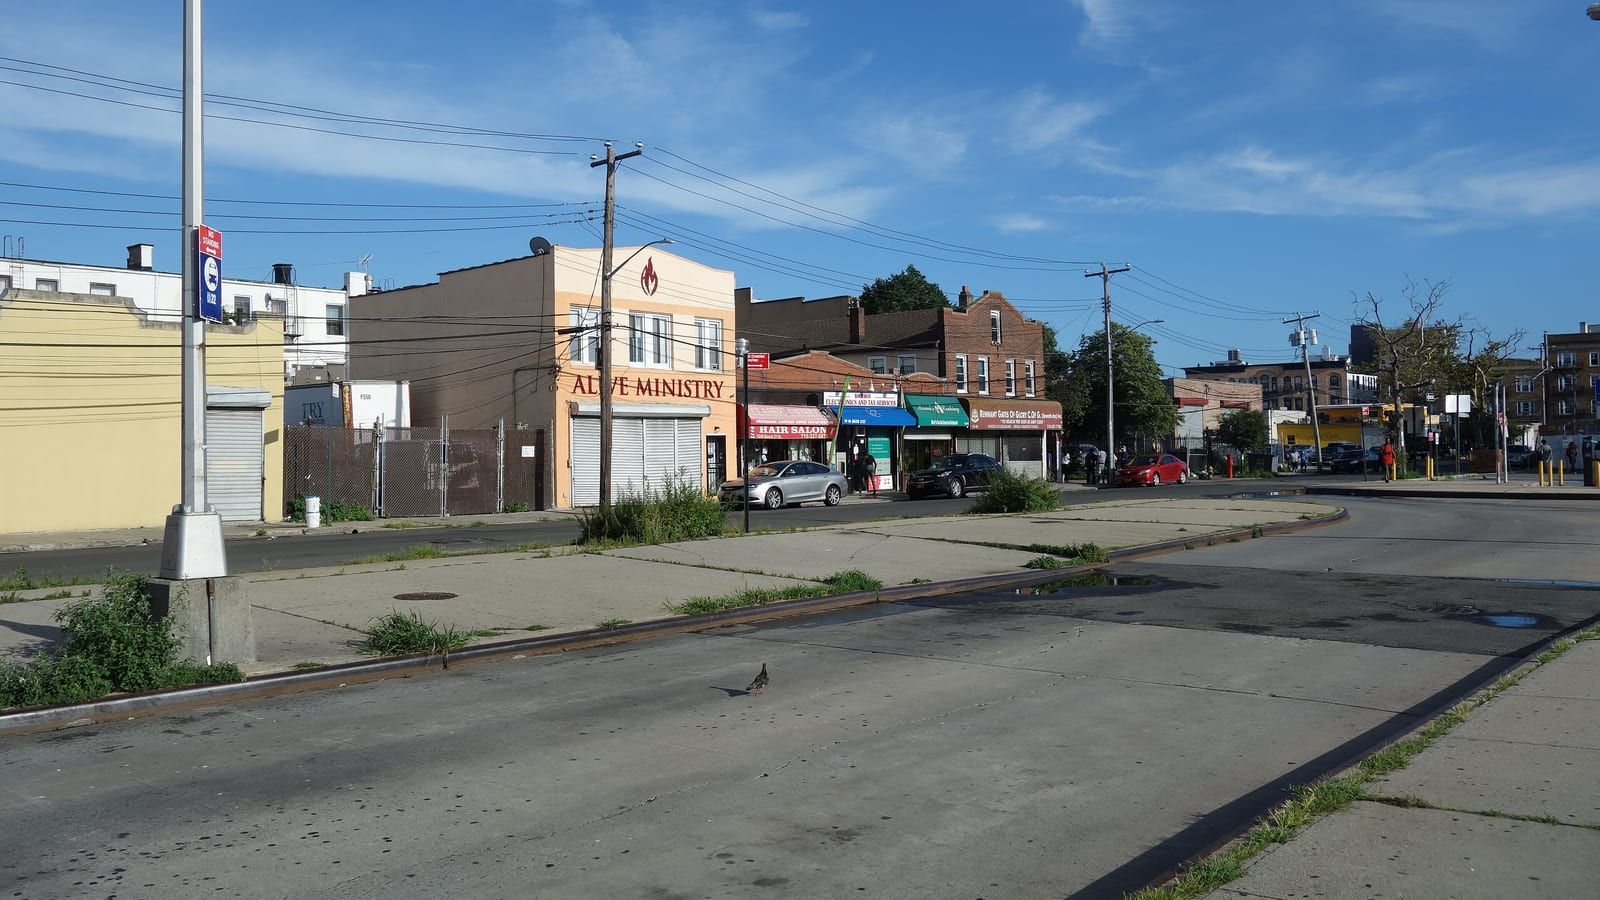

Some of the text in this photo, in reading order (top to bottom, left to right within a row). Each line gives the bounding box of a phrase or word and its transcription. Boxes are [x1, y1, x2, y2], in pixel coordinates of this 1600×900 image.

[208, 230, 214, 239] NO
[203, 238, 219, 249] STANDING
[572, 374, 724, 399] ALVE MINISTRY
[759, 426, 827, 434] HAIR SALON
